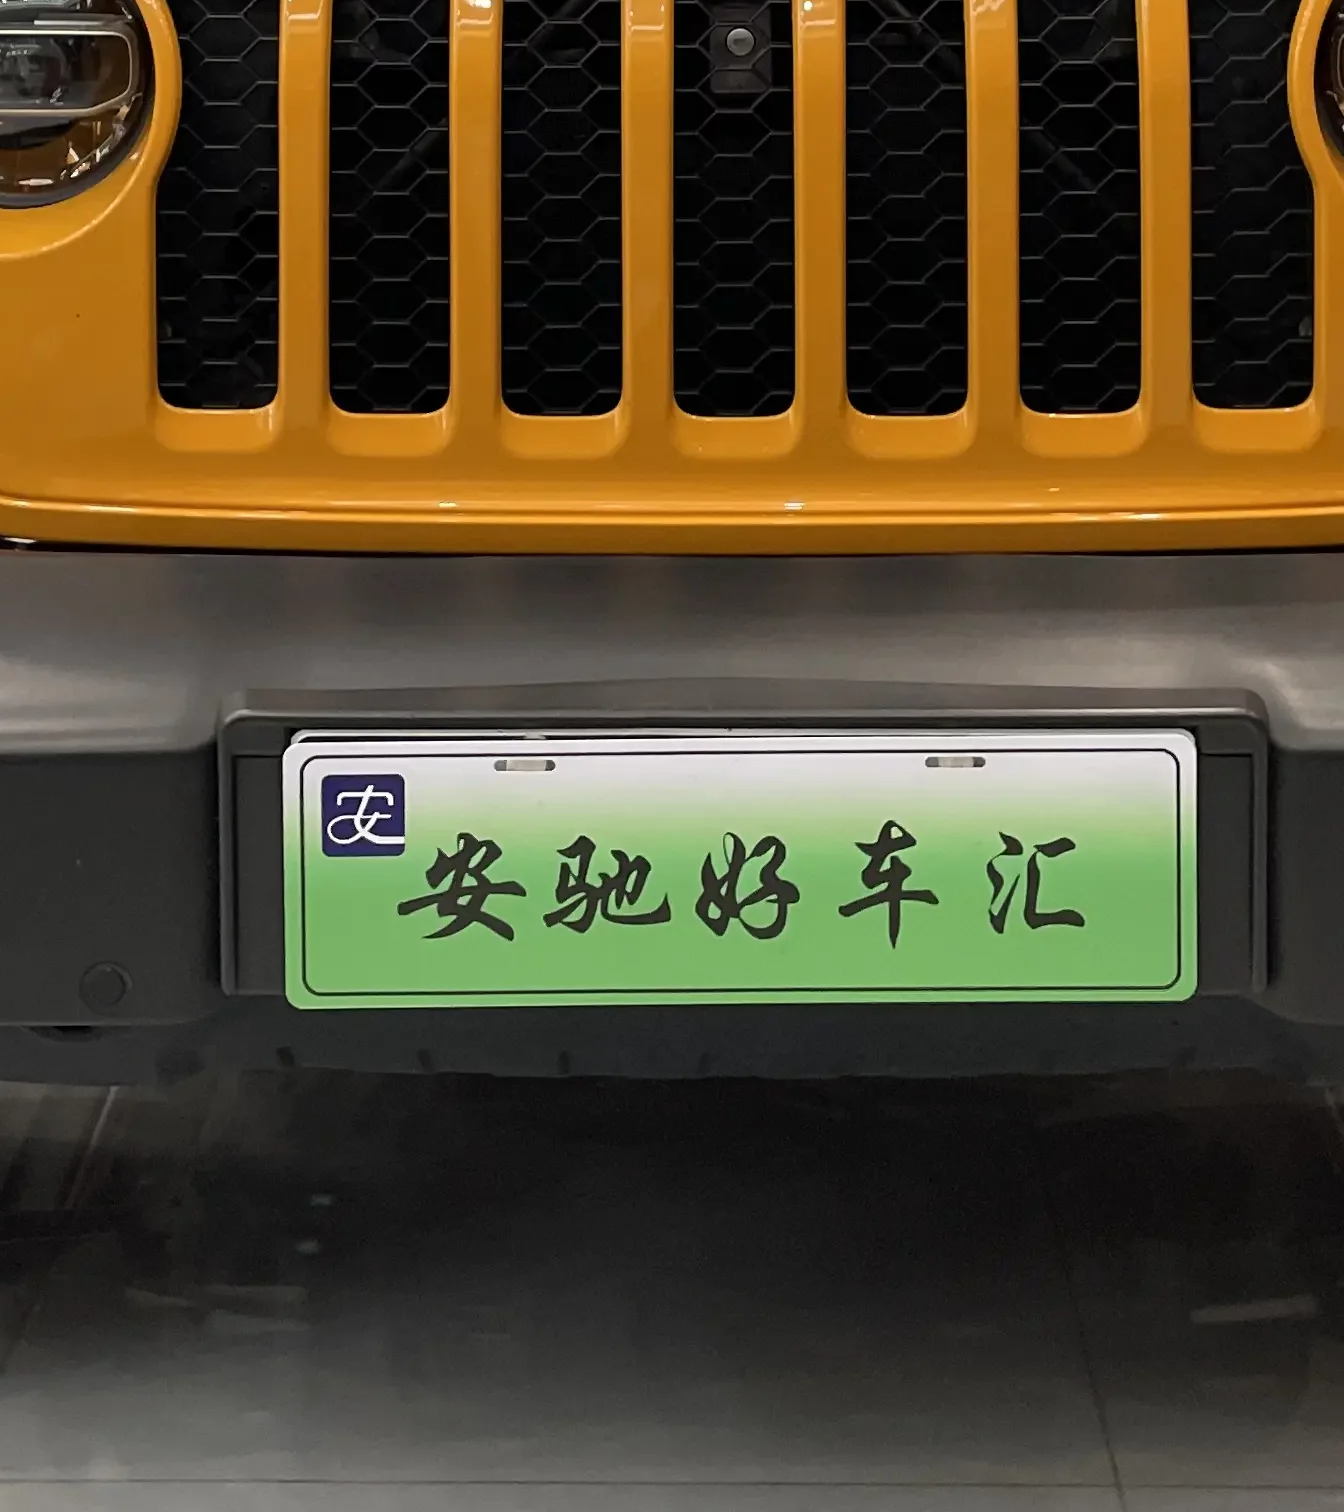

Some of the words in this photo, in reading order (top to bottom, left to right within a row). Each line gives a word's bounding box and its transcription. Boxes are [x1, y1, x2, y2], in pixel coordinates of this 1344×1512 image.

[398, 819, 1085, 949] 安驰好车汇
